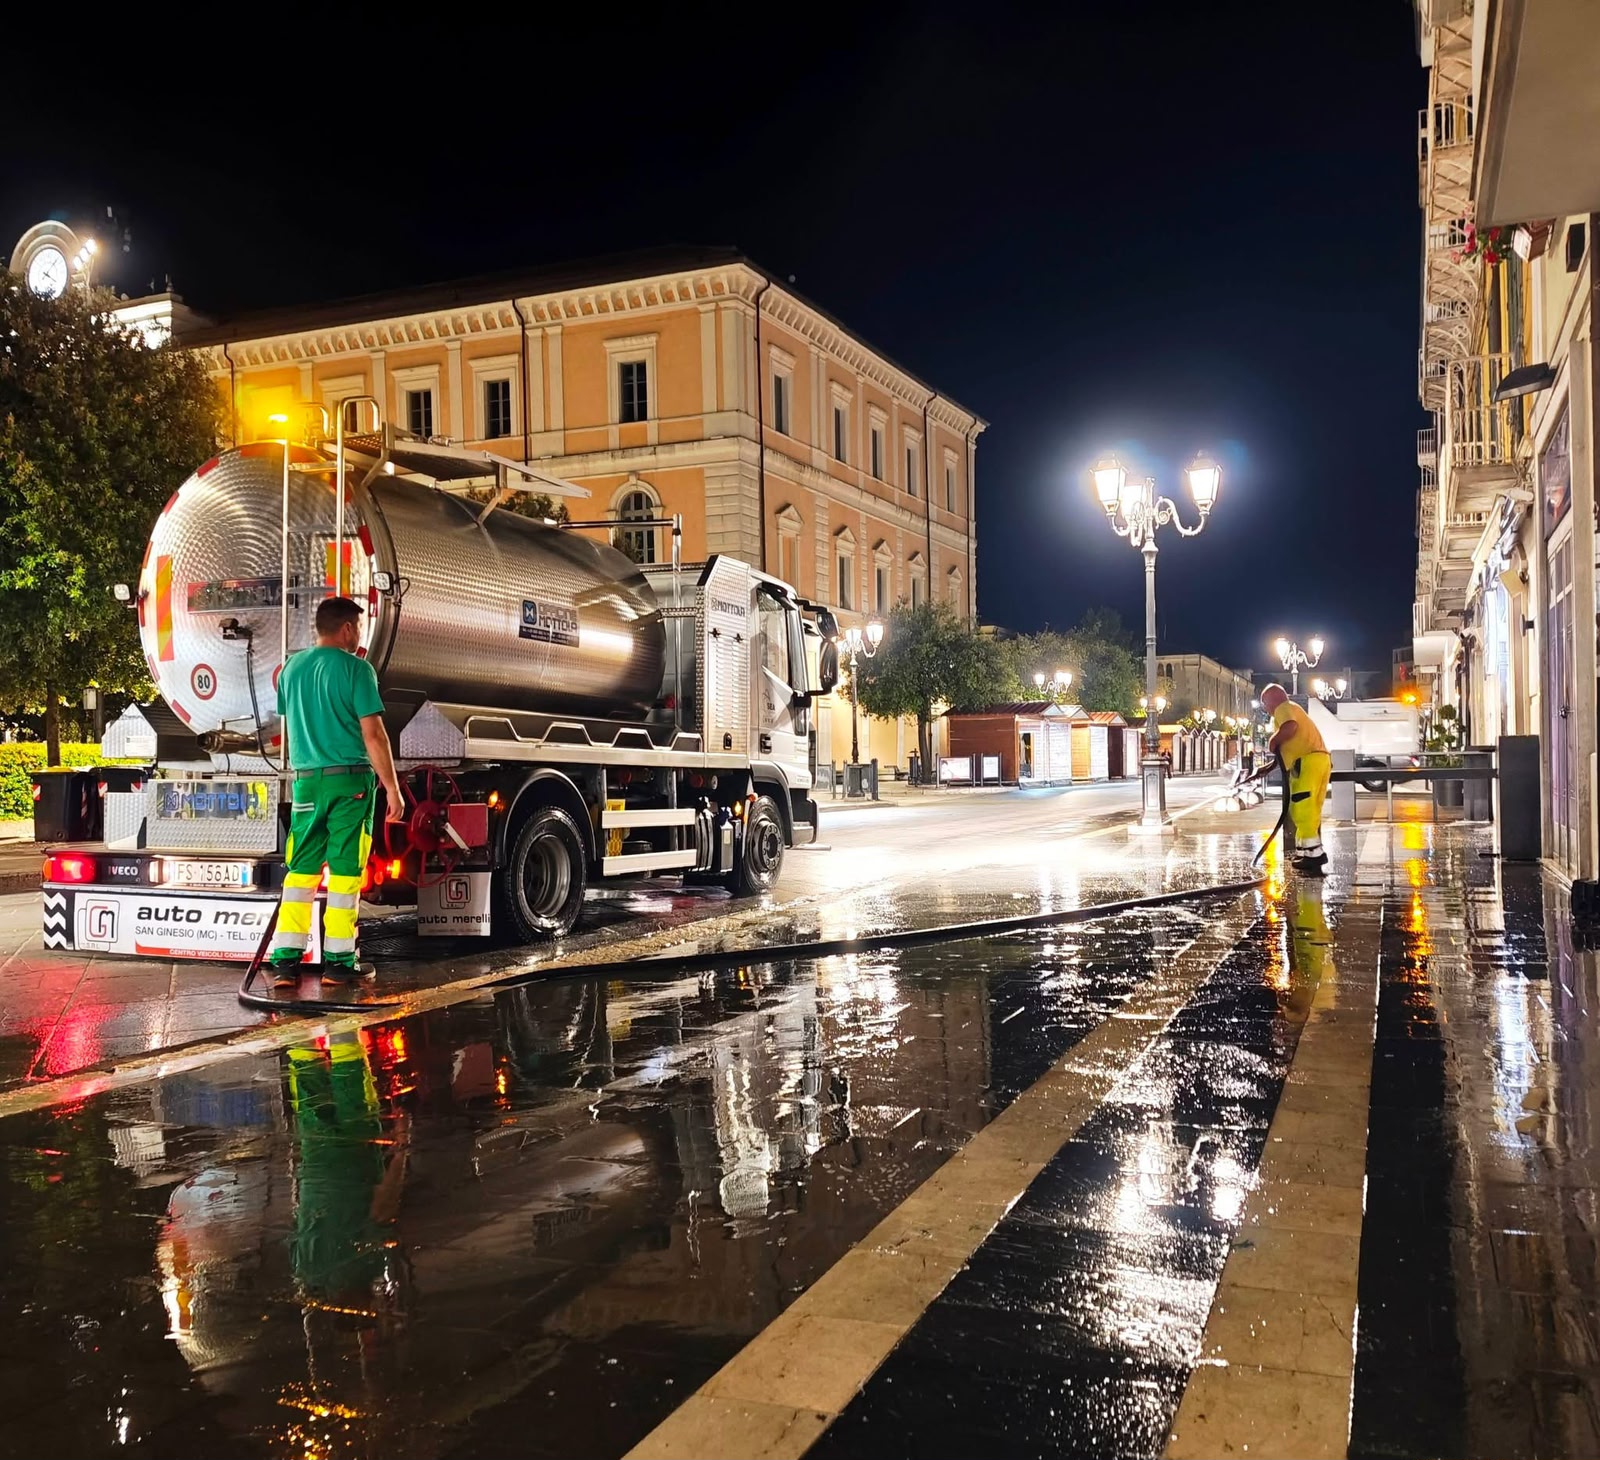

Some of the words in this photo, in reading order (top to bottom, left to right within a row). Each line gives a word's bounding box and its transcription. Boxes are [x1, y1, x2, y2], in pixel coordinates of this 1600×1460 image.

[197, 674, 210, 689] 80
[108, 866, 138, 876] IVECO
[177, 863, 193, 881] FS
[136, 905, 203, 923] auto
[418, 914, 448, 924] auto
[135, 925, 154, 936] SAN
[156, 927, 195, 939] GINESIO
[196, 929, 218, 941] (MC)
[226, 931, 247, 941] TEL.
